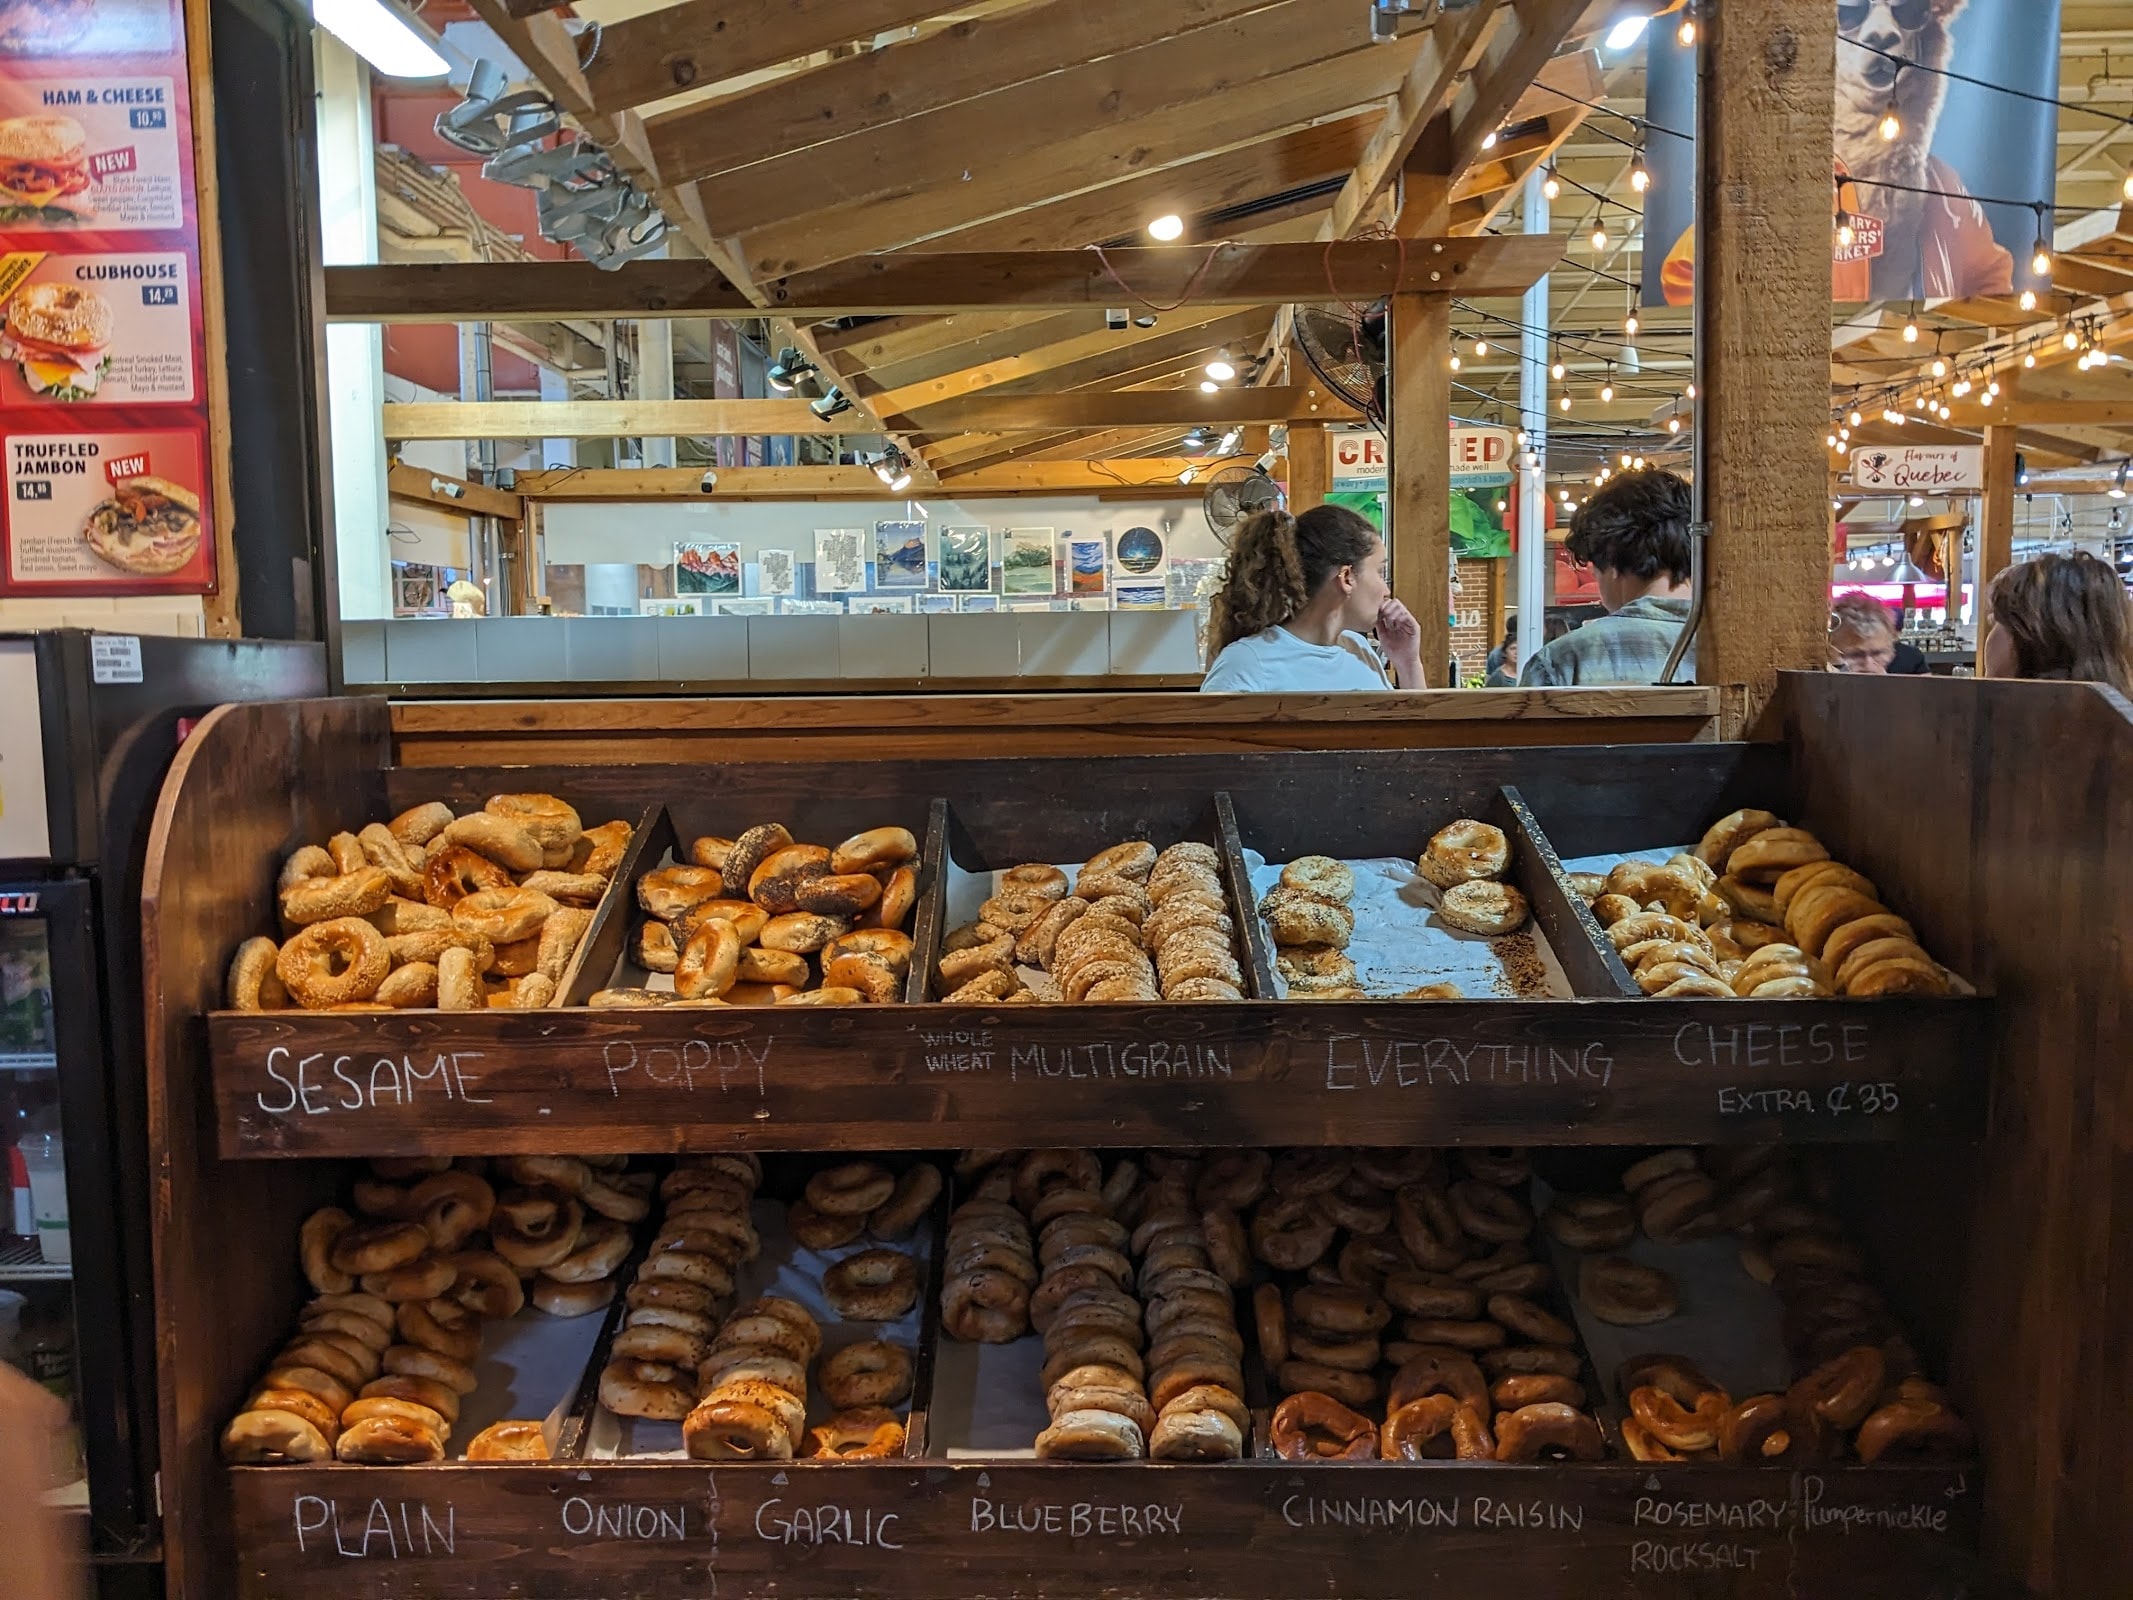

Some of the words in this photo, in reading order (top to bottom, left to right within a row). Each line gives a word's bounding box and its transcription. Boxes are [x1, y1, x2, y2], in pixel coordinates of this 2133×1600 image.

[43, 90, 81, 105] HAM
[86, 89, 98, 105] &
[102, 87, 164, 105] CHEESE
[95, 151, 129, 174] NEW
[76, 264, 178, 280] CLUBHOUSE
[14, 443, 99, 458] TRUFFLED
[1472, 462, 1490, 471] well
[16, 460, 87, 475] JAMBON
[110, 457, 144, 478] NEW
[1894, 463, 1968, 488] Quebec
[920, 1030, 994, 1048] WHOLE
[1674, 1021, 1869, 1067] CHEESE
[602, 1035, 775, 1098] POPPY
[924, 1051, 996, 1073] WHEAT
[1010, 1040, 1232, 1082] MULTIGRAIN
[1326, 1033, 1614, 1090] EVERYTHING
[257, 1046, 494, 1114] SESAME
[295, 1494, 455, 1559] PLAIN
[562, 1496, 686, 1541] ONION
[755, 1498, 903, 1550] GARLIC
[970, 1497, 1184, 1537] BLUEBERRY
[1282, 1494, 1459, 1527] CINNAMON
[1473, 1496, 1583, 1529] RAISIN
[1634, 1496, 1787, 1528] ROSEMARY
[1631, 1539, 1761, 1573] ROCKSALT
